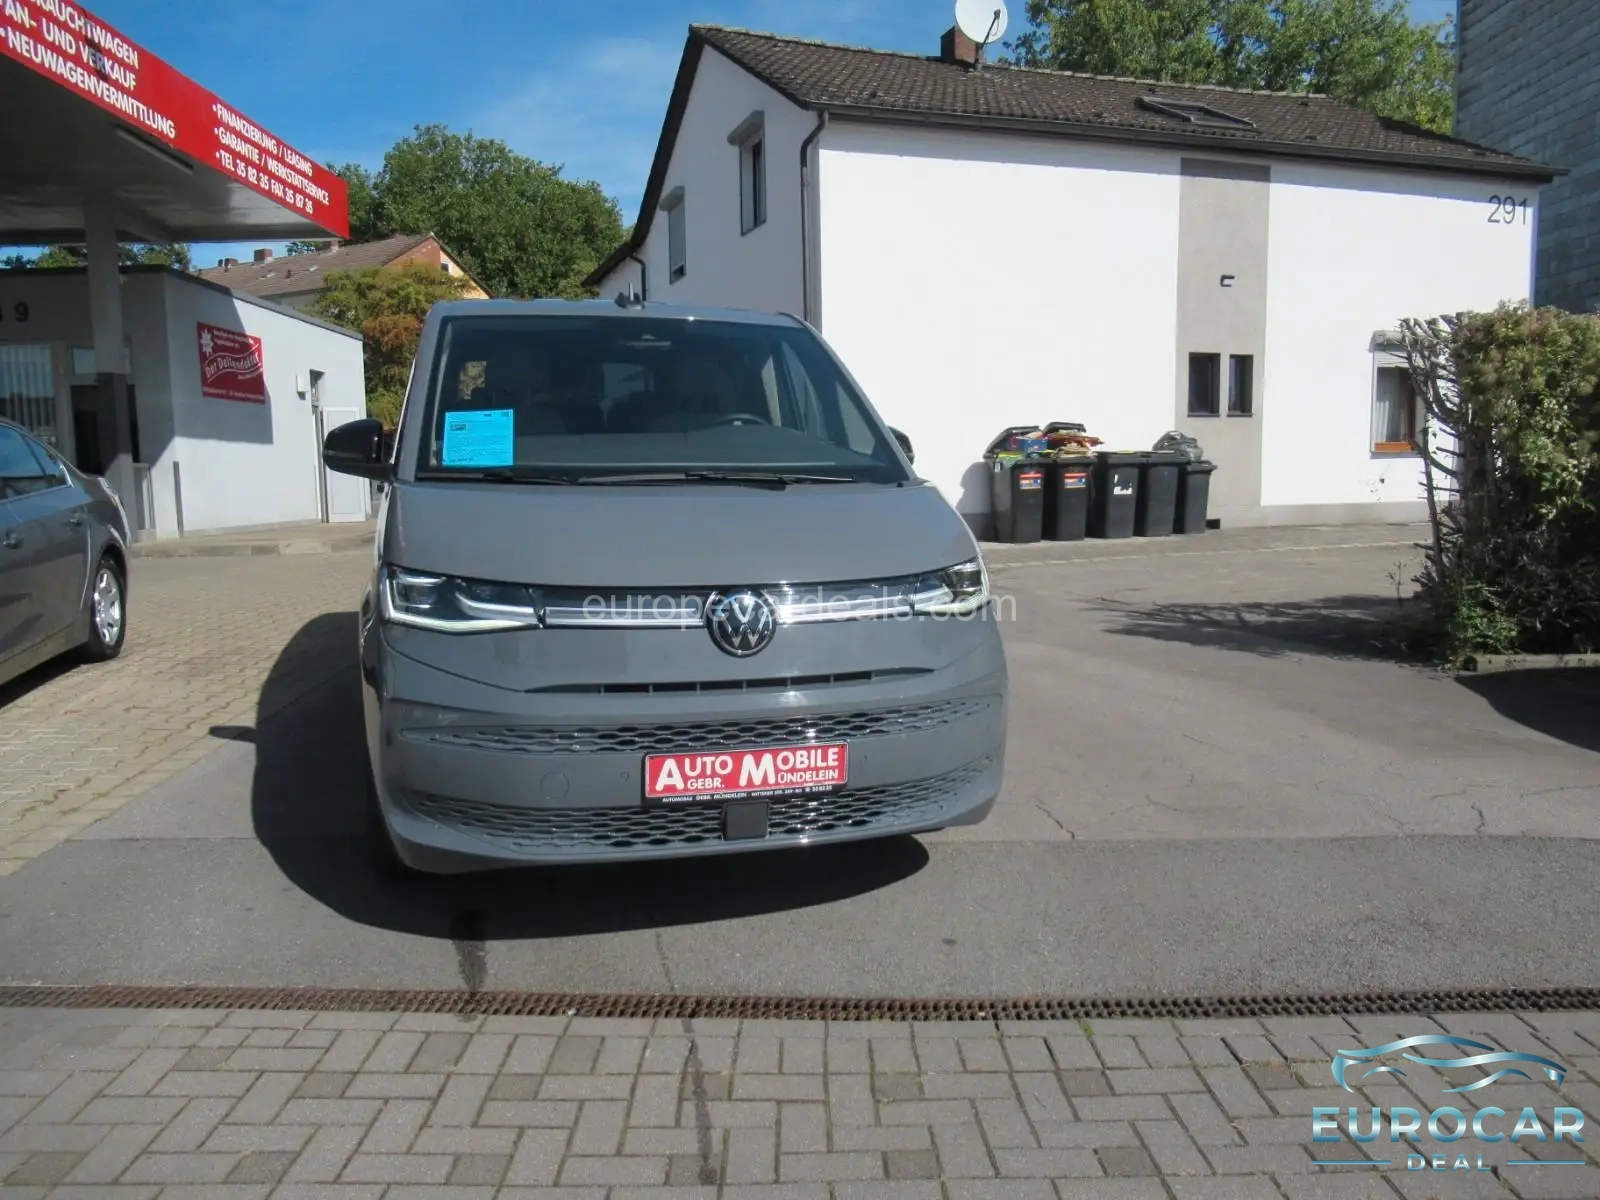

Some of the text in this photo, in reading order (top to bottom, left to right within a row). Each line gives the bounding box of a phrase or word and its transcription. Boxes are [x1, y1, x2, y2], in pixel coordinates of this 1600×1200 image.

[7, 26, 176, 138] NEUWAGENVERMITTLUNG
[42, 17, 76, 55] UND
[79, 41, 136, 92] VERKAUF
[216, 104, 278, 154] FINANZIERUNG
[283, 147, 313, 177] LEASING
[219, 126, 260, 164] GARANTIE
[266, 156, 330, 206] WERKSTATTSERVICE
[219, 149, 236, 172] TEL
[270, 179, 285, 200] FAX
[1487, 194, 1528, 225] 291
[655, 755, 734, 792] AUTO
[687, 777, 725, 790] GEBR.
